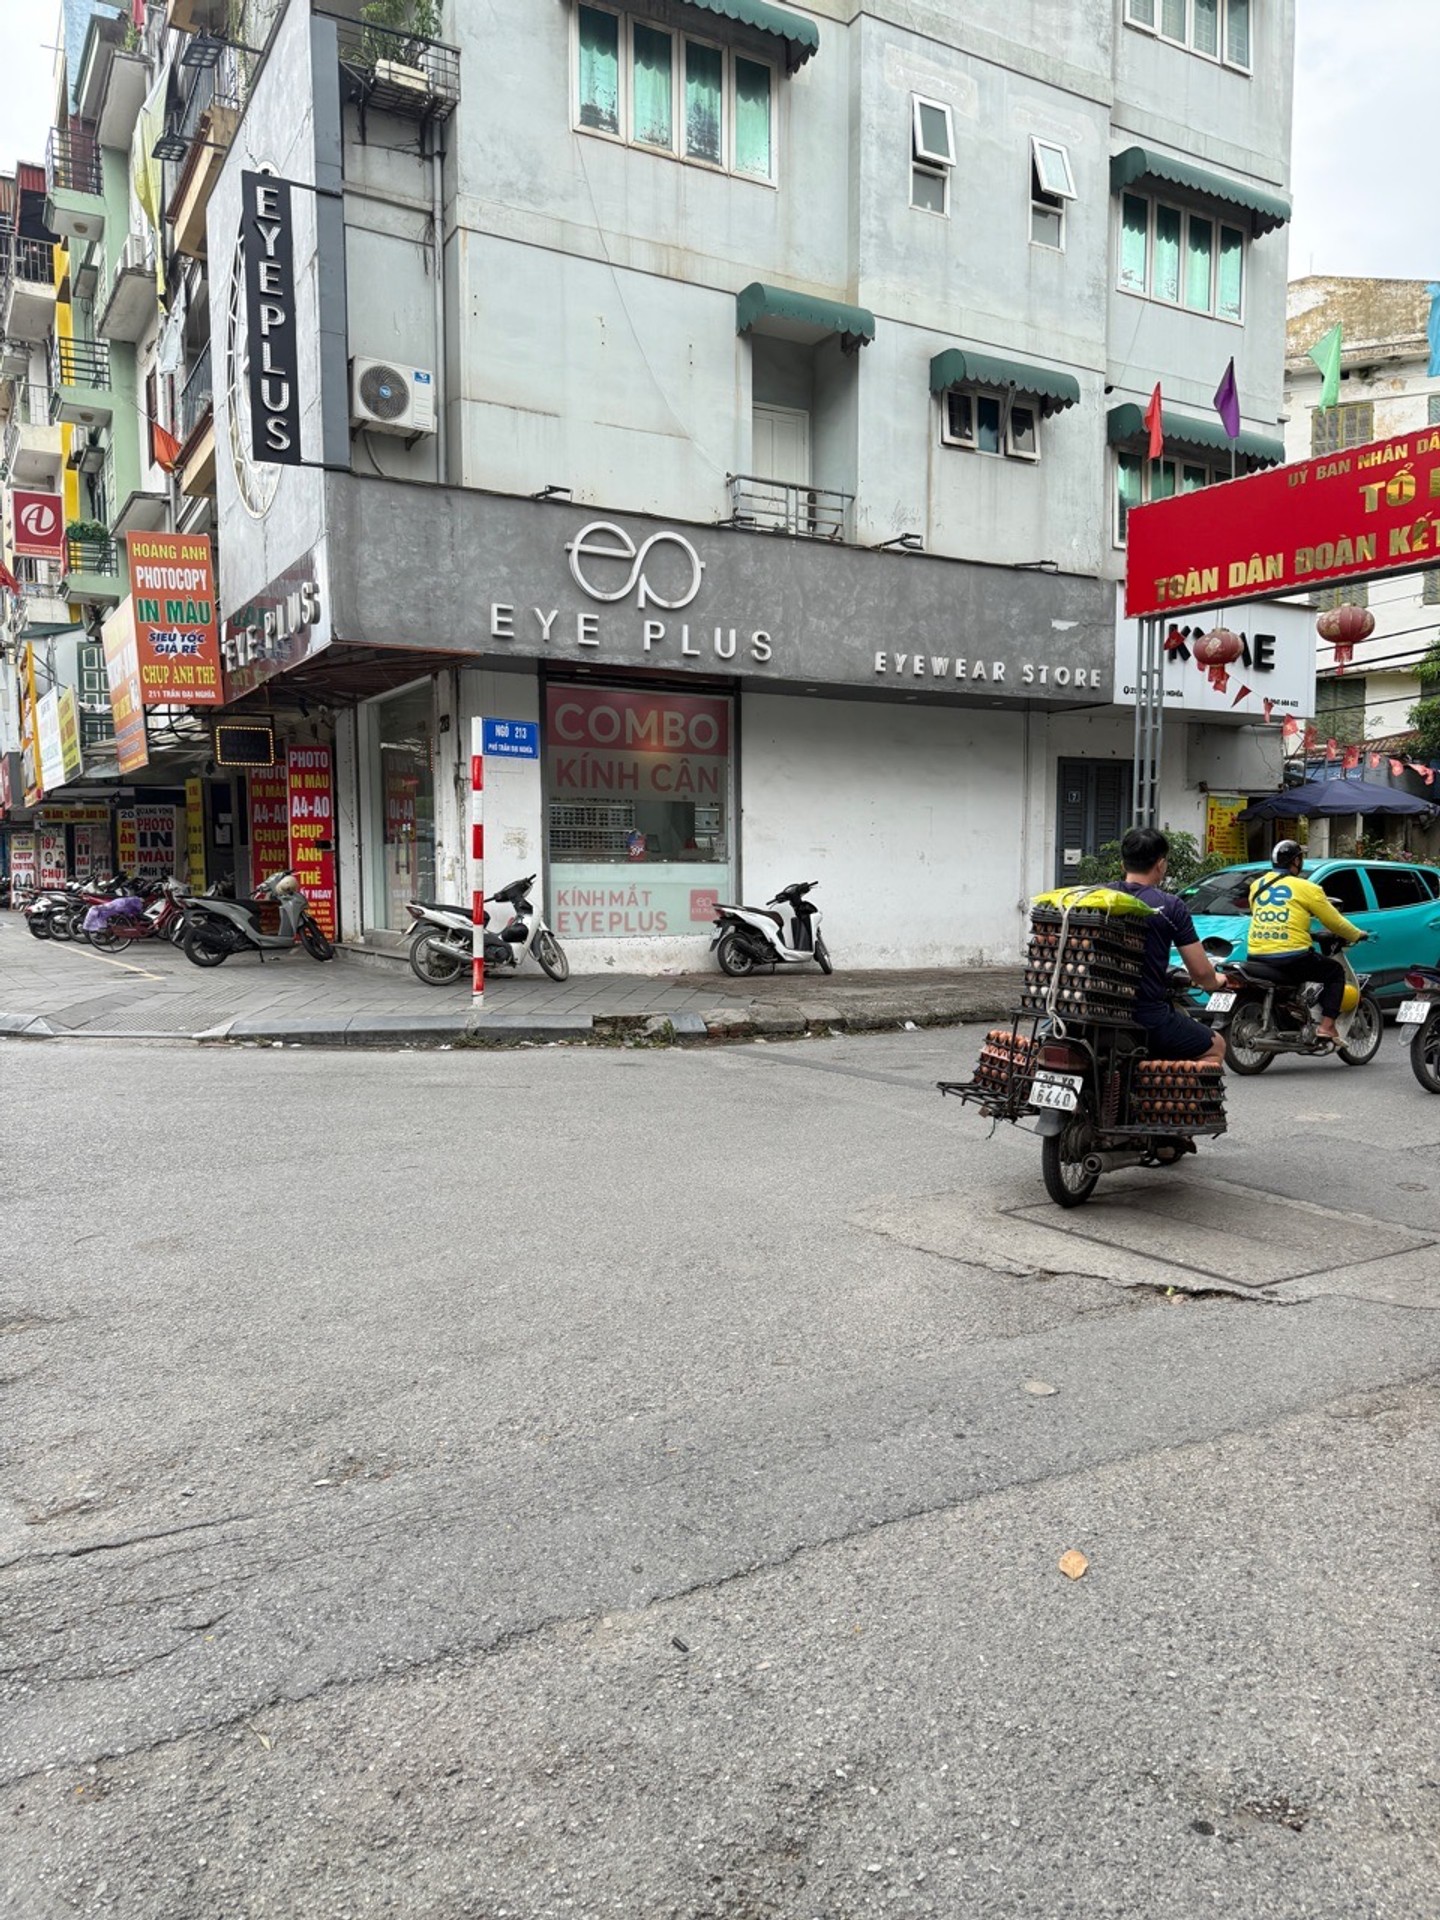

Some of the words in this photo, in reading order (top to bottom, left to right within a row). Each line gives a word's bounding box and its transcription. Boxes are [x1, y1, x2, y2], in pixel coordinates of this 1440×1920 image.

[1316, 459, 1351, 481] BAN
[1358, 443, 1408, 470] NHÂN
[1359, 463, 1417, 514] TỔ
[132, 541, 177, 559] HOÀNG
[181, 546, 207, 561] ANH
[135, 565, 207, 591] PHOTOCOPY
[1154, 562, 1219, 603] TOÀN
[1228, 552, 1284, 588] DÂN
[1294, 534, 1377, 576] ĐOÀN
[137, 599, 160, 624] IN
[166, 595, 212, 625] MÀU
[491, 603, 602, 647] EYE
[644, 620, 773, 663] PLUS
[142, 665, 170, 689] CHỤP
[172, 658, 195, 684] ẢNH
[195, 658, 217, 685] THẺ
[874, 651, 1006, 682] EYEWEAR
[1022, 664, 1102, 688] STORE
[514, 727, 527, 739] 213
[555, 702, 720, 750] COMBO
[289, 751, 329, 768] PHOTO
[557, 749, 640, 791] KÍNH
[290, 774, 302, 788] IN
[305, 771, 329, 788] MÀU
[252, 785, 263, 797] IN
[137, 818, 174, 831] PHOTO
[291, 824, 324, 842] CHỤP
[139, 832, 173, 847] IN
[138, 848, 174, 863] MÀU
[259, 844, 287, 862] ẢNH
[296, 842, 323, 862] ẢNH
[300, 866, 322, 884] THẺ
[557, 886, 605, 907] KÍNH
[609, 884, 653, 907] MẮT
[557, 911, 604, 933] EYE
[609, 911, 668, 932] PLUS
